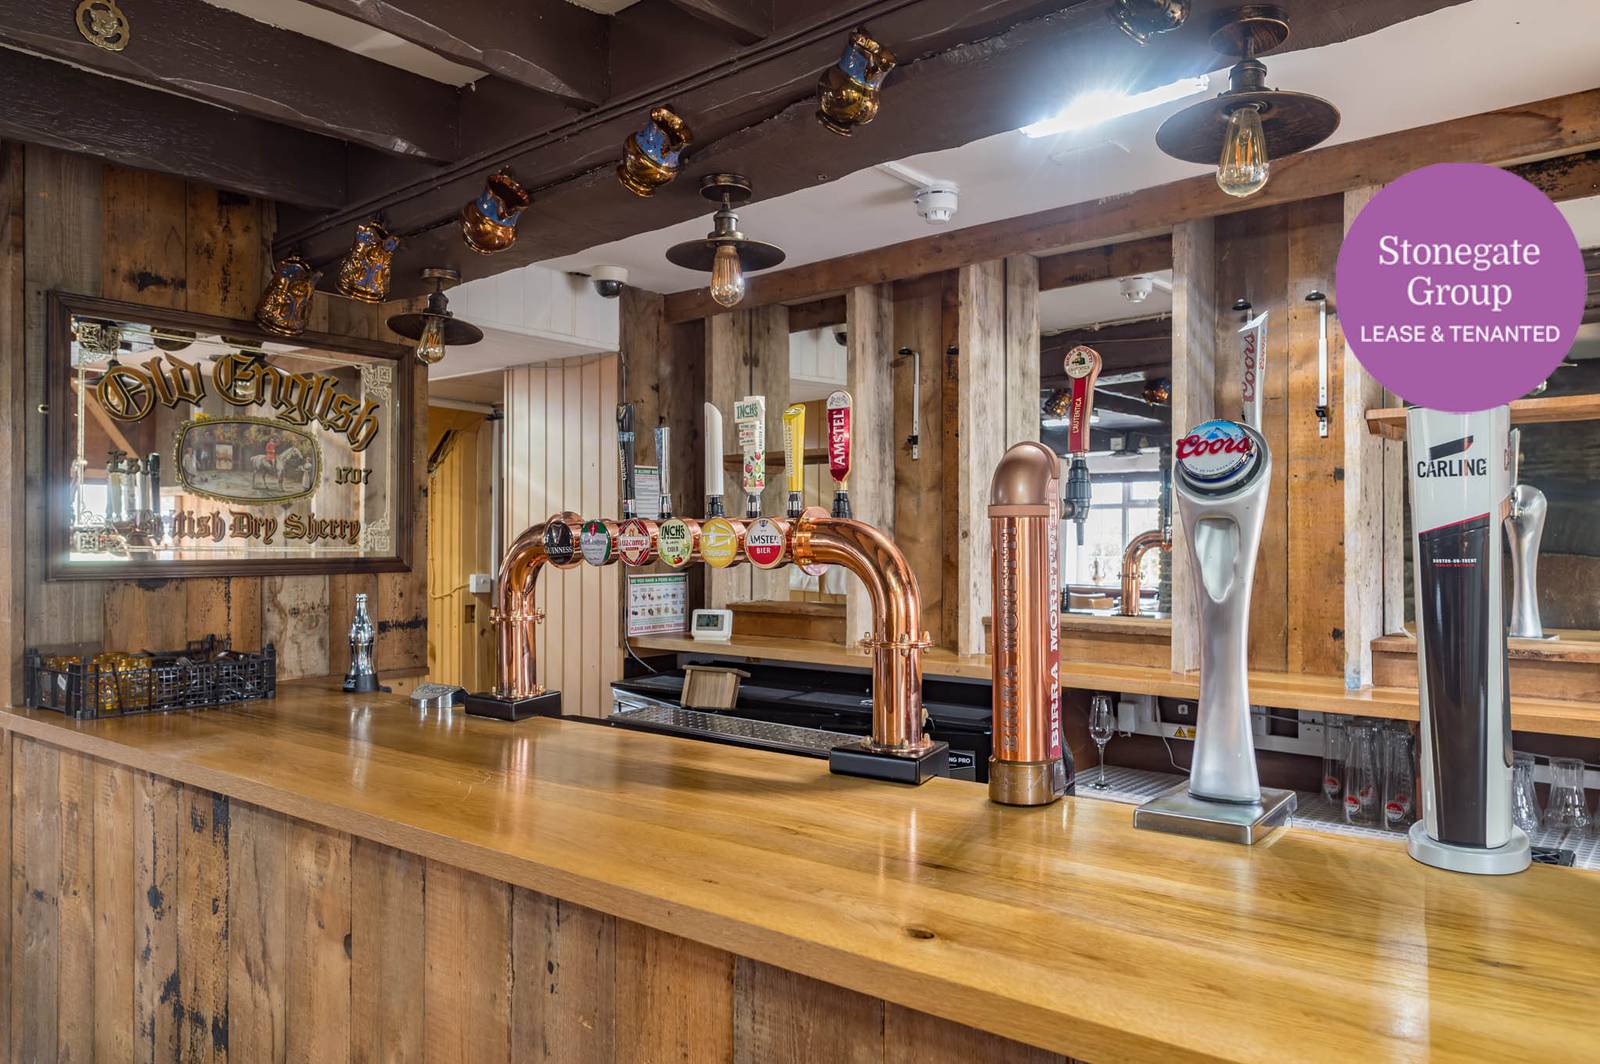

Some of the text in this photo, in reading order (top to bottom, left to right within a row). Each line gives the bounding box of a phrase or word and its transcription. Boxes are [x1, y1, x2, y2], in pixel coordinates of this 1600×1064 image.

[1243, 331, 1256, 402] Coors
[97, 352, 380, 452] Old English
[833, 410, 846, 465] AMSTEL
[1176, 434, 1253, 460] Coors
[335, 466, 373, 485] 1707
[1417, 458, 1487, 478] CARLING
[229, 509, 278, 545] Dry
[283, 511, 361, 546] Sherry
[1050, 661, 1059, 748] BIRRA
